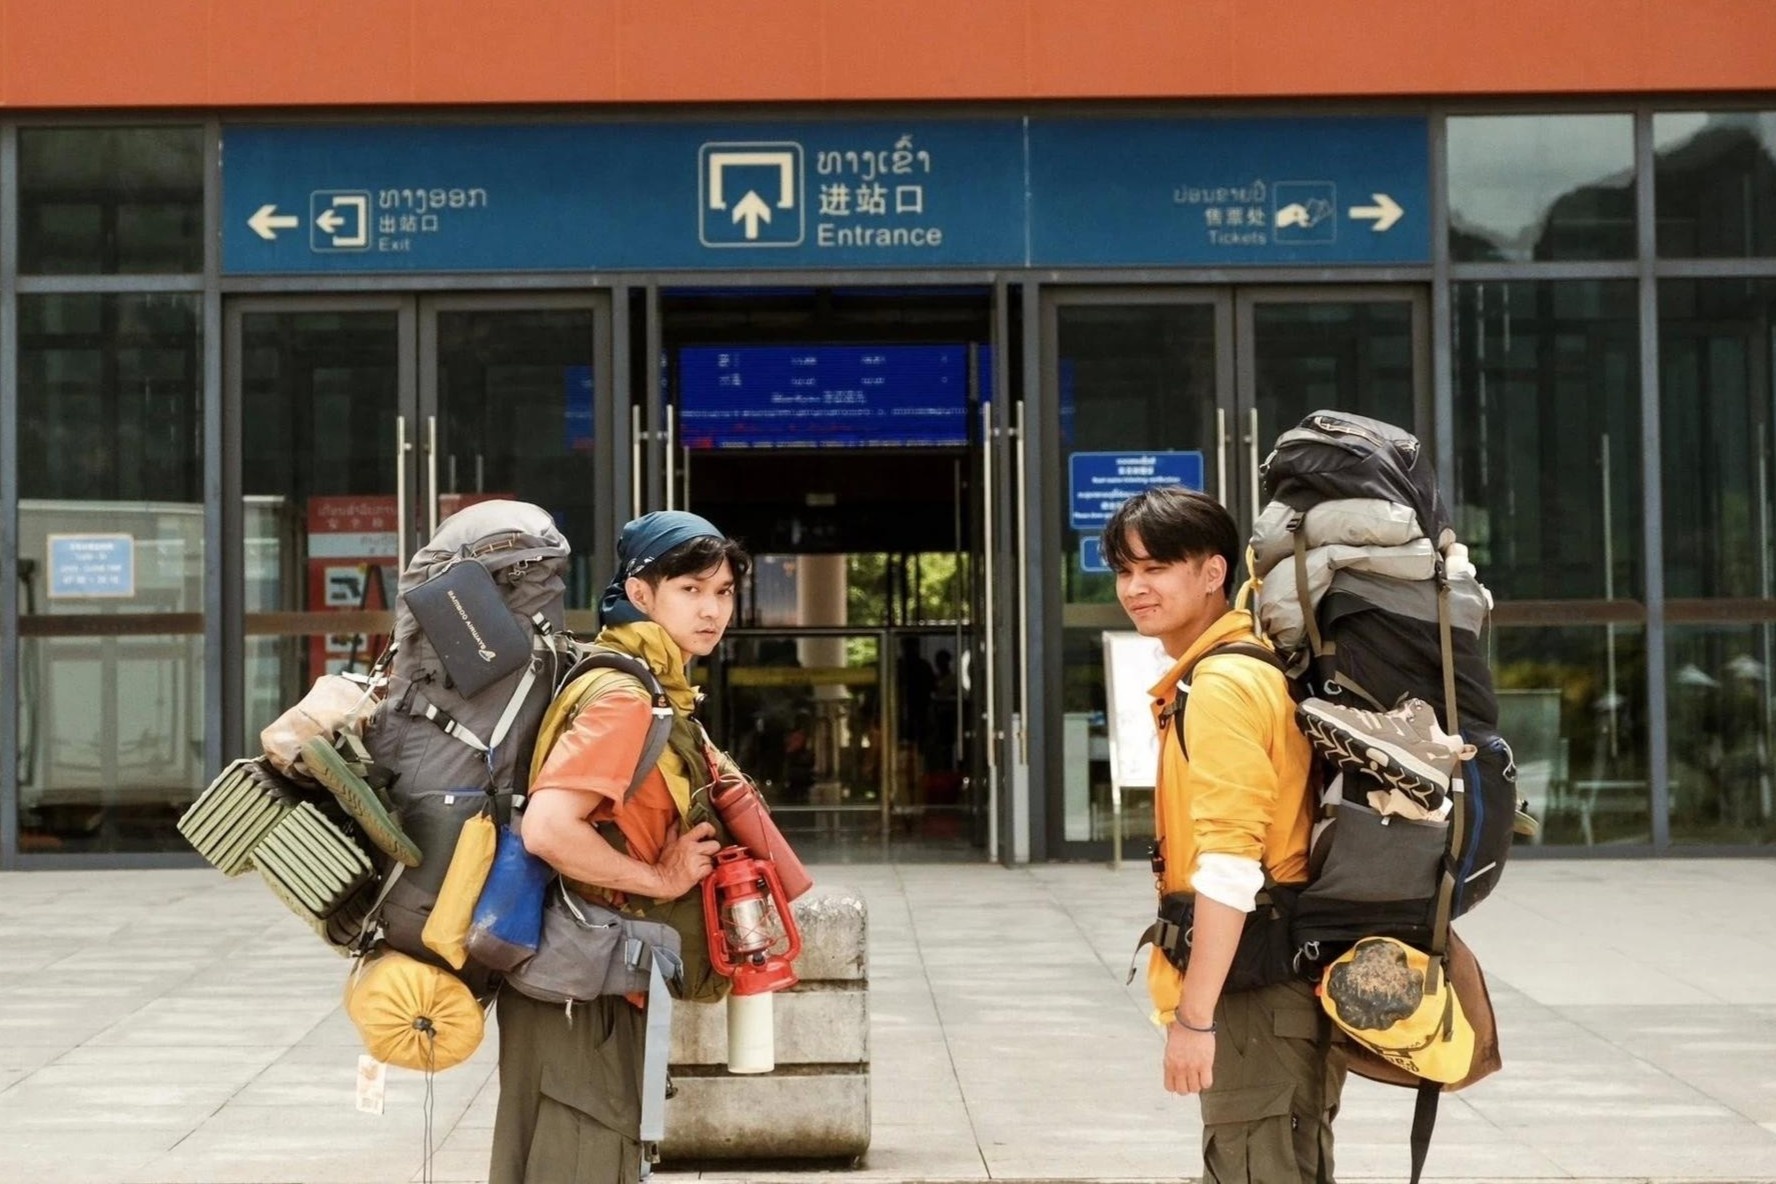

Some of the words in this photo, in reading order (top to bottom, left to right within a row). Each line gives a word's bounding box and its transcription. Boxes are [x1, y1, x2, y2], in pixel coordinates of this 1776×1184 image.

[379, 188, 488, 214] ທາງອອກ
[818, 182, 923, 216] 进站口
[379, 214, 438, 234] 出站口
[1204, 206, 1266, 226] 售票处
[378, 237, 410, 252] Exit
[817, 223, 943, 247] Entrance
[1208, 229, 1267, 246] Tickets
[447, 590, 468, 621] BAMBOO
[465, 620, 487, 650] AIRWAYS
